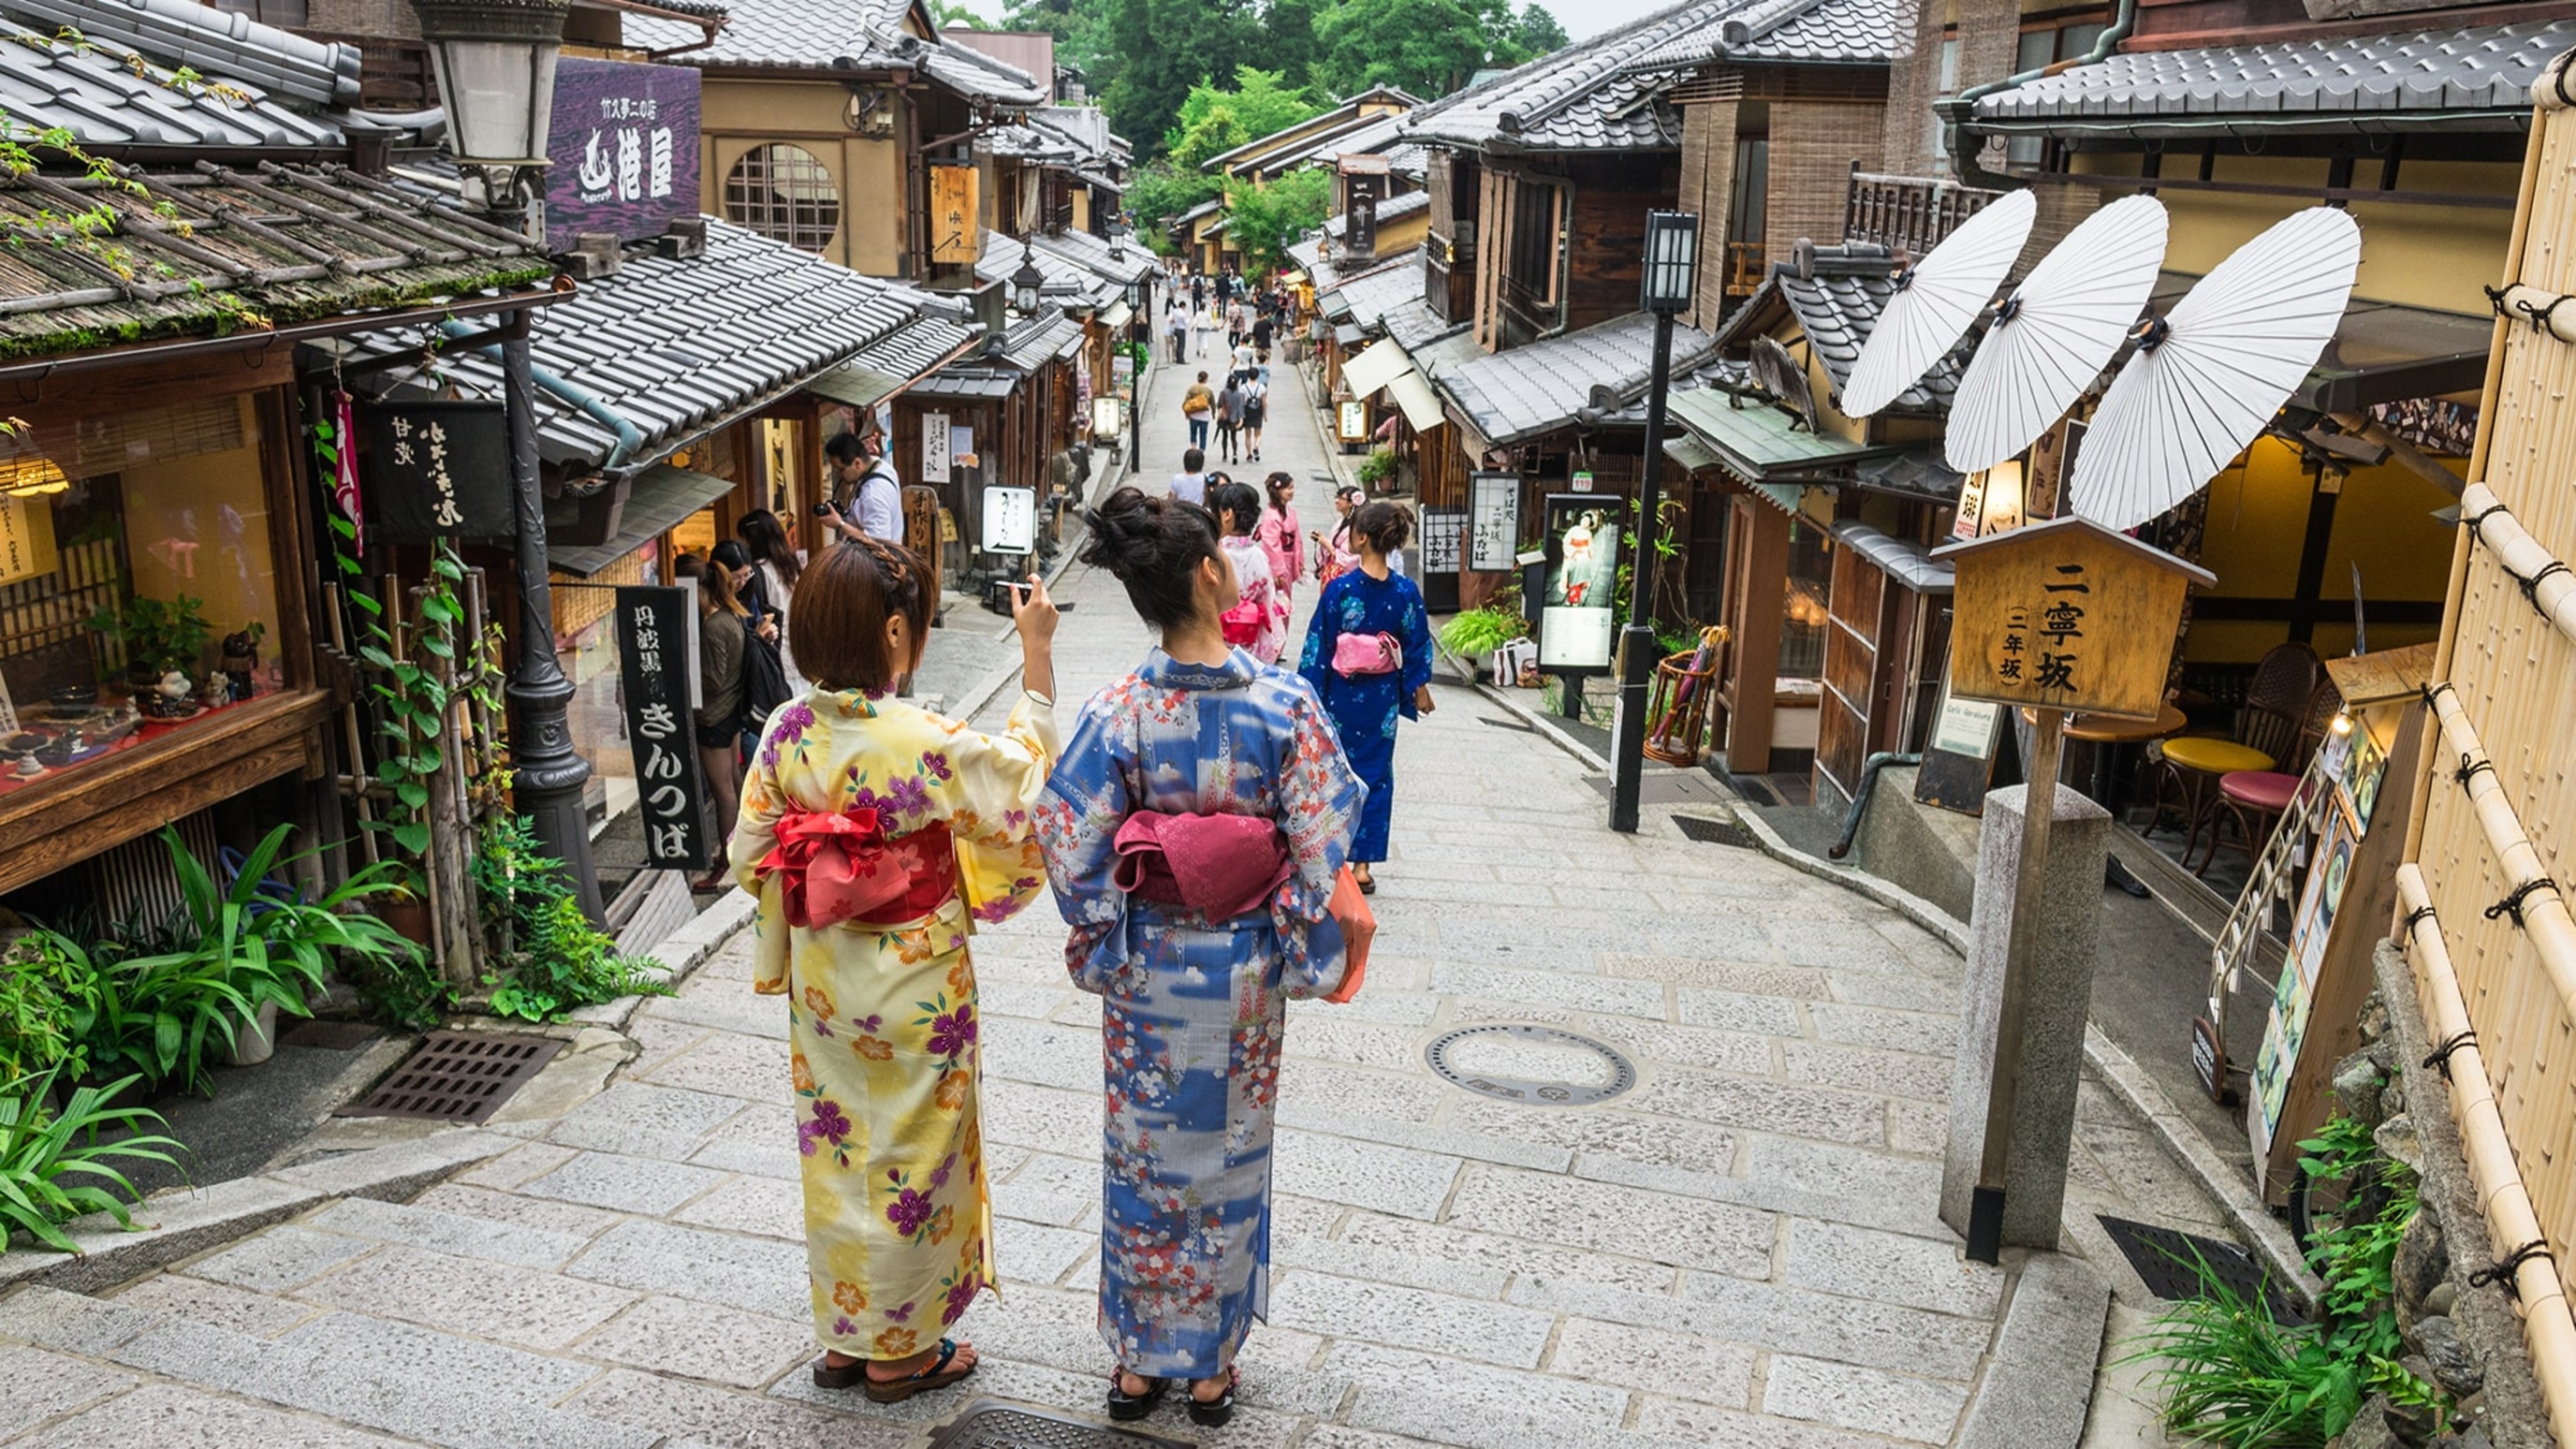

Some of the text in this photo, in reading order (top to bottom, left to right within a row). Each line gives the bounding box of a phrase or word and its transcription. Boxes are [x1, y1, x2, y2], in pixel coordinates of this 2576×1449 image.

[601, 97, 658, 121] 竹久夢二の店
[617, 126, 673, 202] 港屋
[1574, 479, 1591, 488] 119
[1503, 486, 1516, 521] そば処
[1474, 523, 1490, 562] ふたば
[1955, 520, 1976, 538] COFFEE
[1428, 534, 1442, 567] ふたば
[1998, 605, 2028, 688] （二年坂）
[2034, 564, 2090, 693] 二寧坂
[638, 702, 690, 859] きんつば
